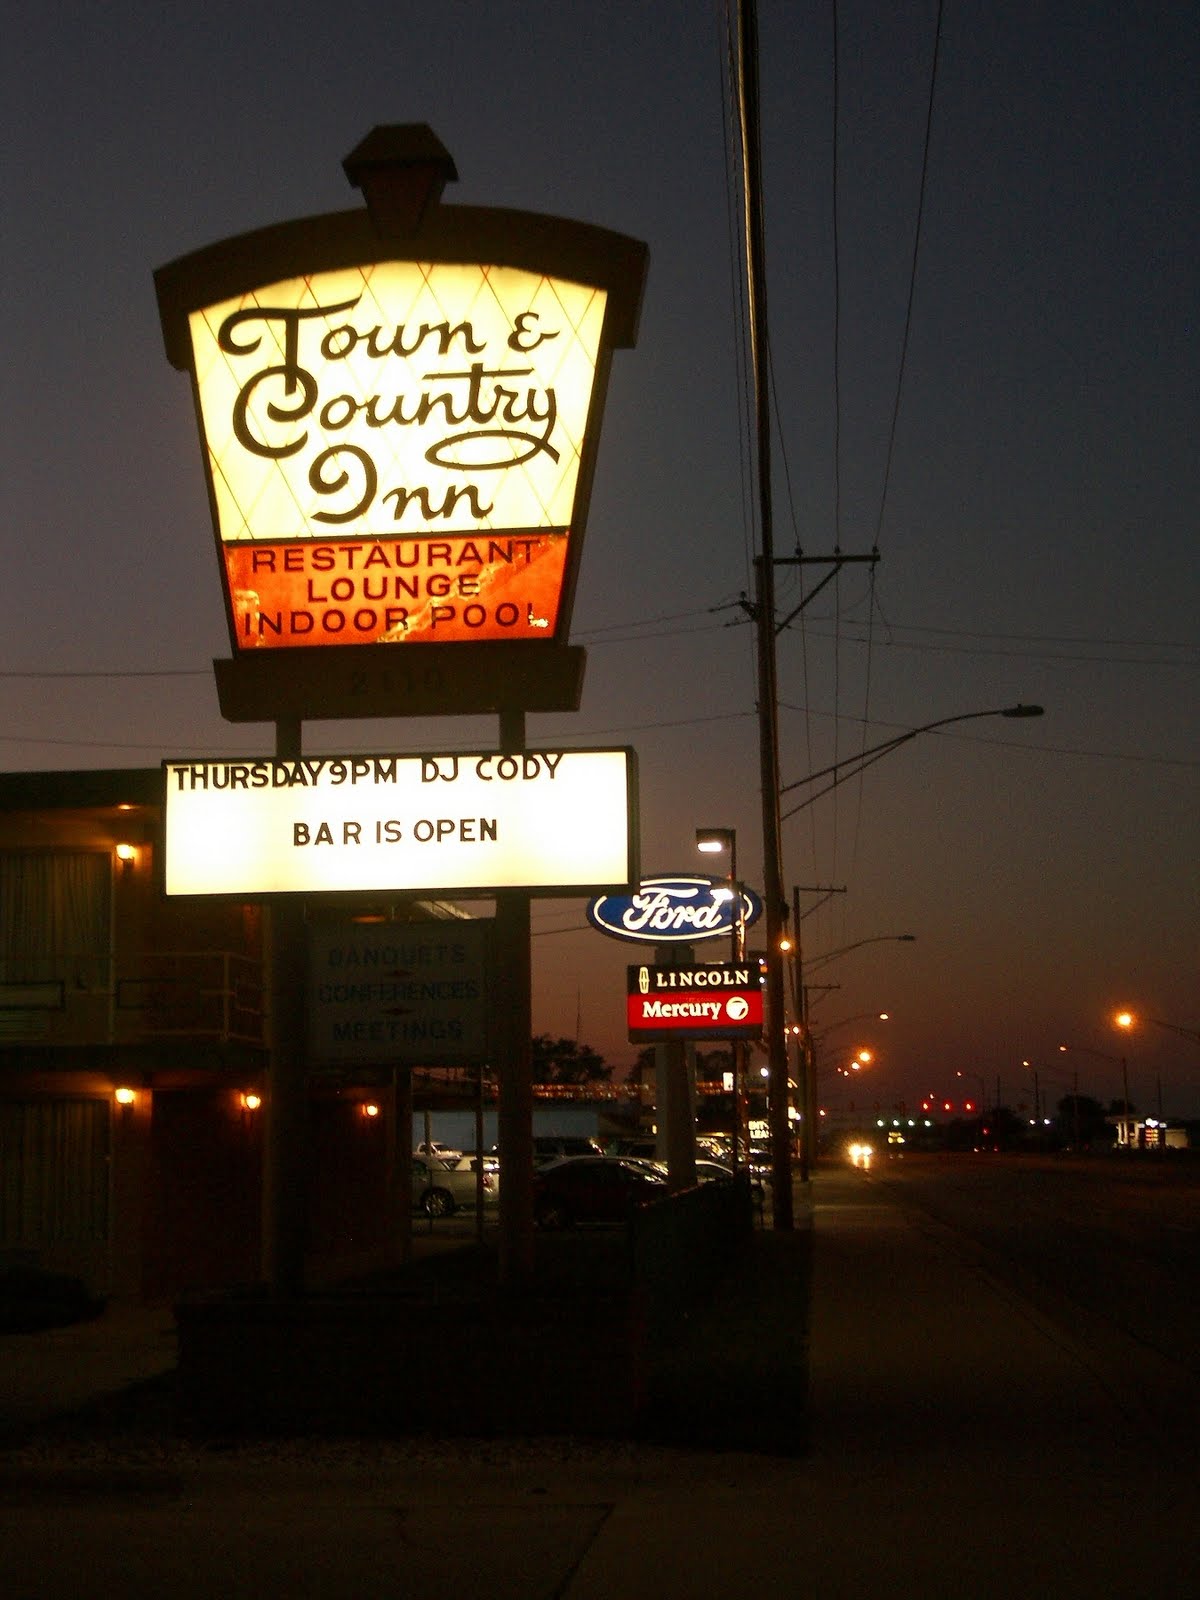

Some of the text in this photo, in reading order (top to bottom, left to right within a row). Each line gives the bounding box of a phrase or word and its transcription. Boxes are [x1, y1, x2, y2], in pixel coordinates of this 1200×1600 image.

[218, 293, 560, 397] Town &
[233, 363, 560, 471] Country
[308, 444, 493, 524] Inn
[252, 539, 540, 574] RESTAURANT
[307, 573, 481, 603] LOUNGE
[245, 606, 409, 636] INDOOR
[421, 757, 460, 783] DJ
[475, 753, 564, 782] CODY
[293, 818, 498, 847] BAR IS OPEN
[623, 887, 725, 930] Ford
[656, 970, 749, 987] LINCOLN
[641, 1000, 722, 1020] Mercury
[334, 1020, 464, 1041] MEETINGS
